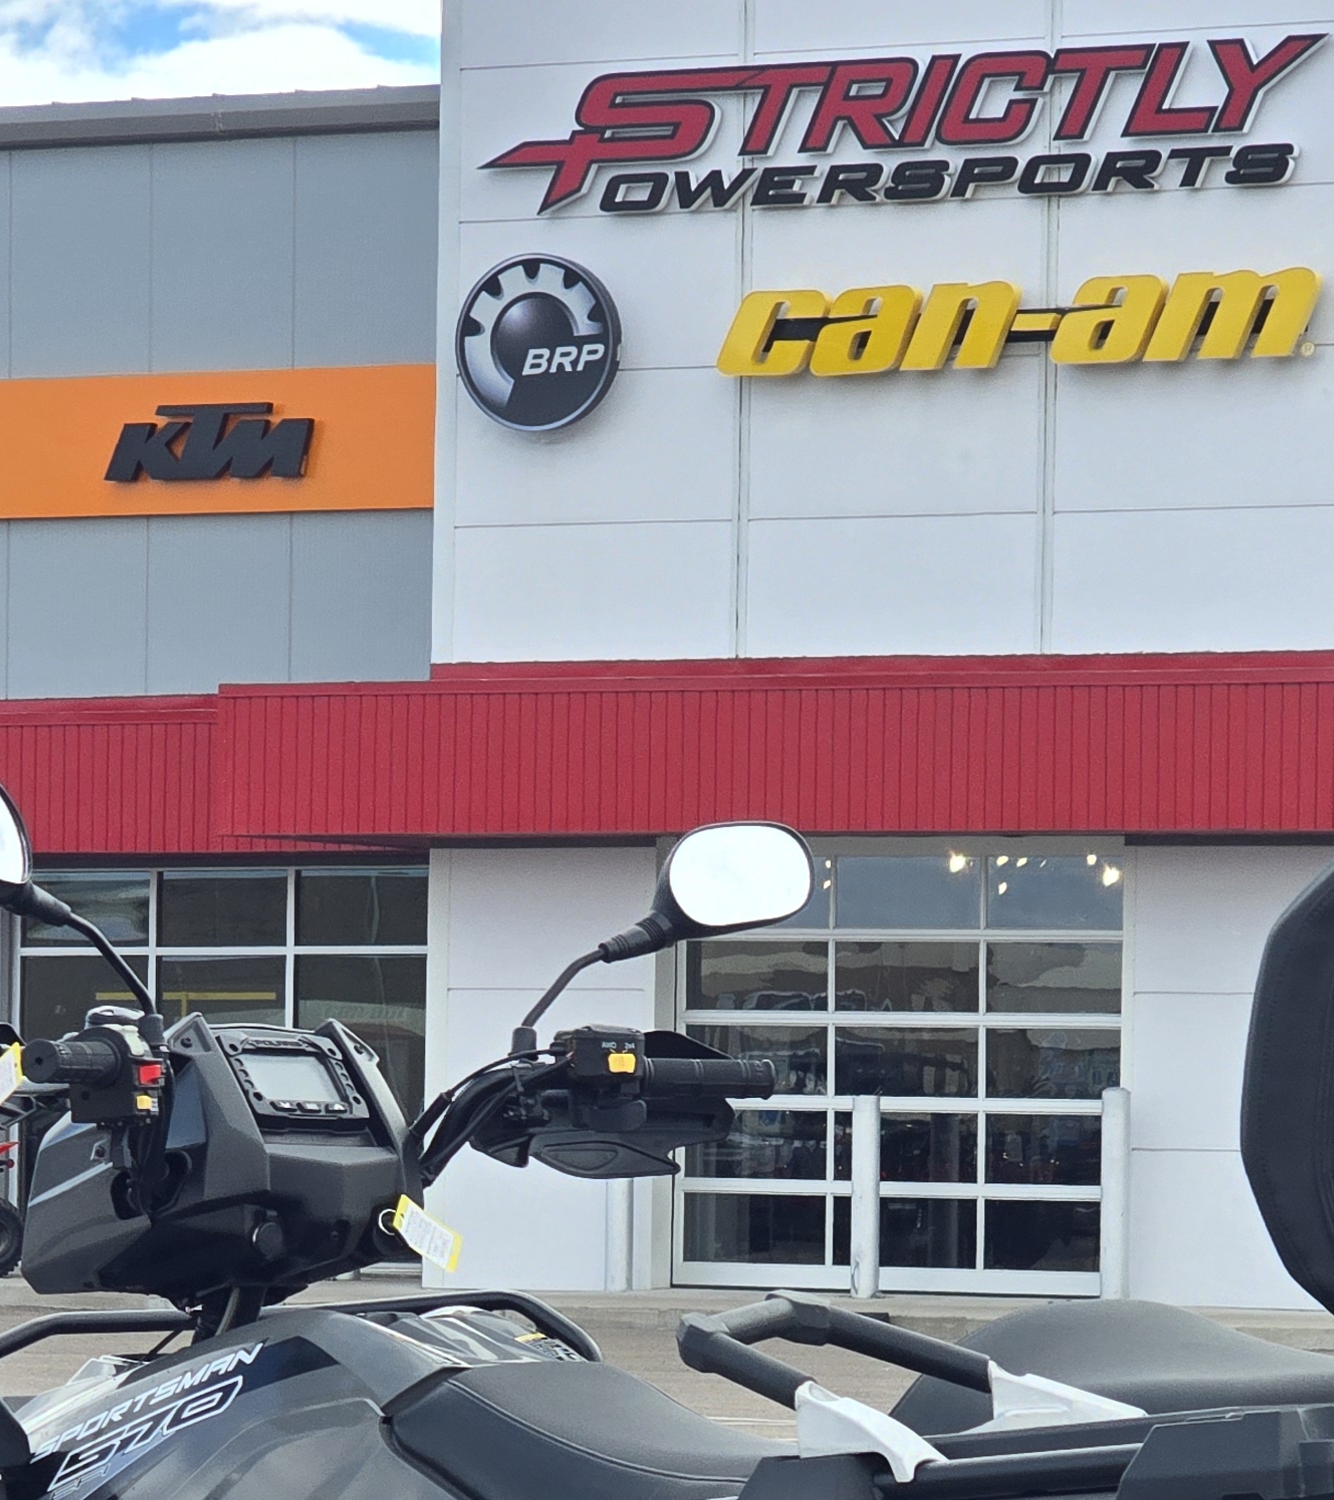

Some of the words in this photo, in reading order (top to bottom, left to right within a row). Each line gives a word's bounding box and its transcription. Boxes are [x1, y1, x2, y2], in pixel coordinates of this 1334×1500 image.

[478, 32, 1330, 166] STRICTLY
[521, 342, 605, 377] BRP
[716, 267, 1325, 378] can-am
[104, 401, 315, 482] KTM
[29, 1342, 264, 1464] SPORTSMAN
